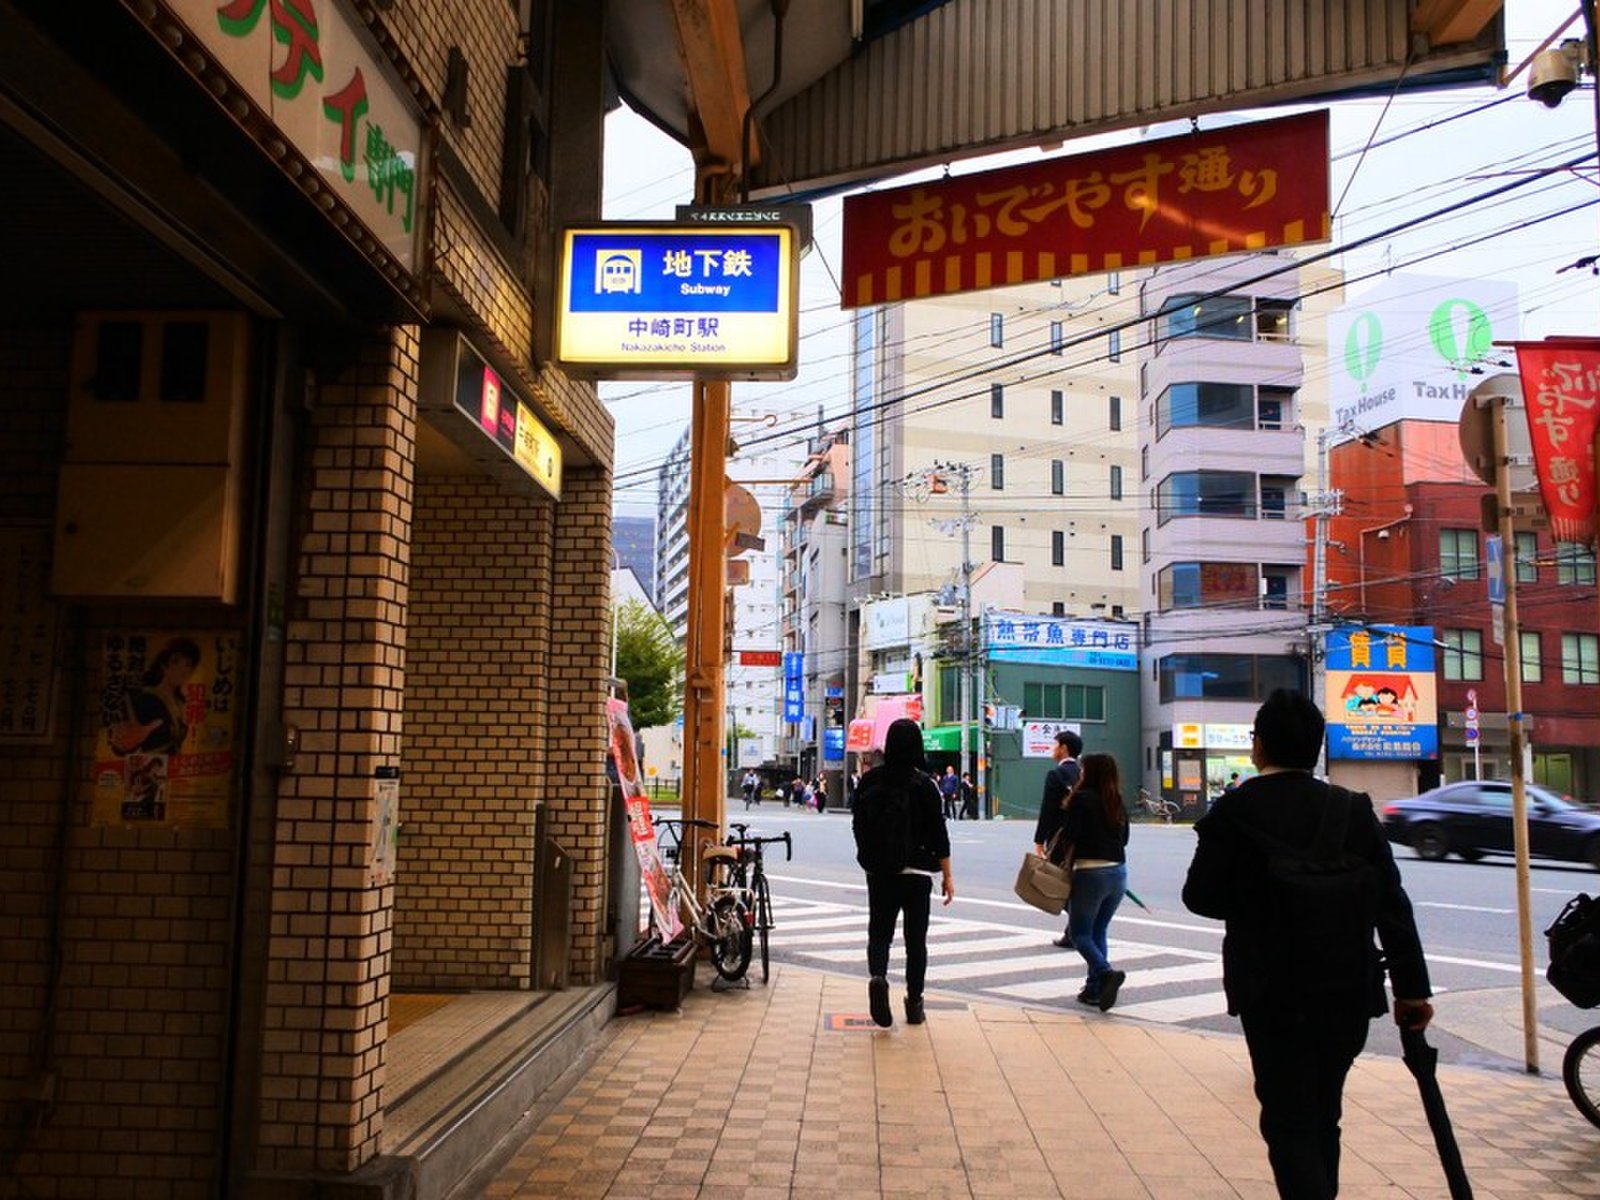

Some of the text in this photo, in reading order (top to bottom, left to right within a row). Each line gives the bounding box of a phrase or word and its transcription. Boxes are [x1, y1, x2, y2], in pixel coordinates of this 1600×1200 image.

[889, 144, 1278, 258] おいでやす通り
[662, 249, 753, 278] 地下鉄
[680, 283, 732, 297] Subway
[628, 317, 720, 338] 中崎町駅
[621, 342, 726, 353] Nakazakicho Station
[997, 618, 1130, 650] 熱帯魚専門店
[212, 636, 235, 711] いじめは
